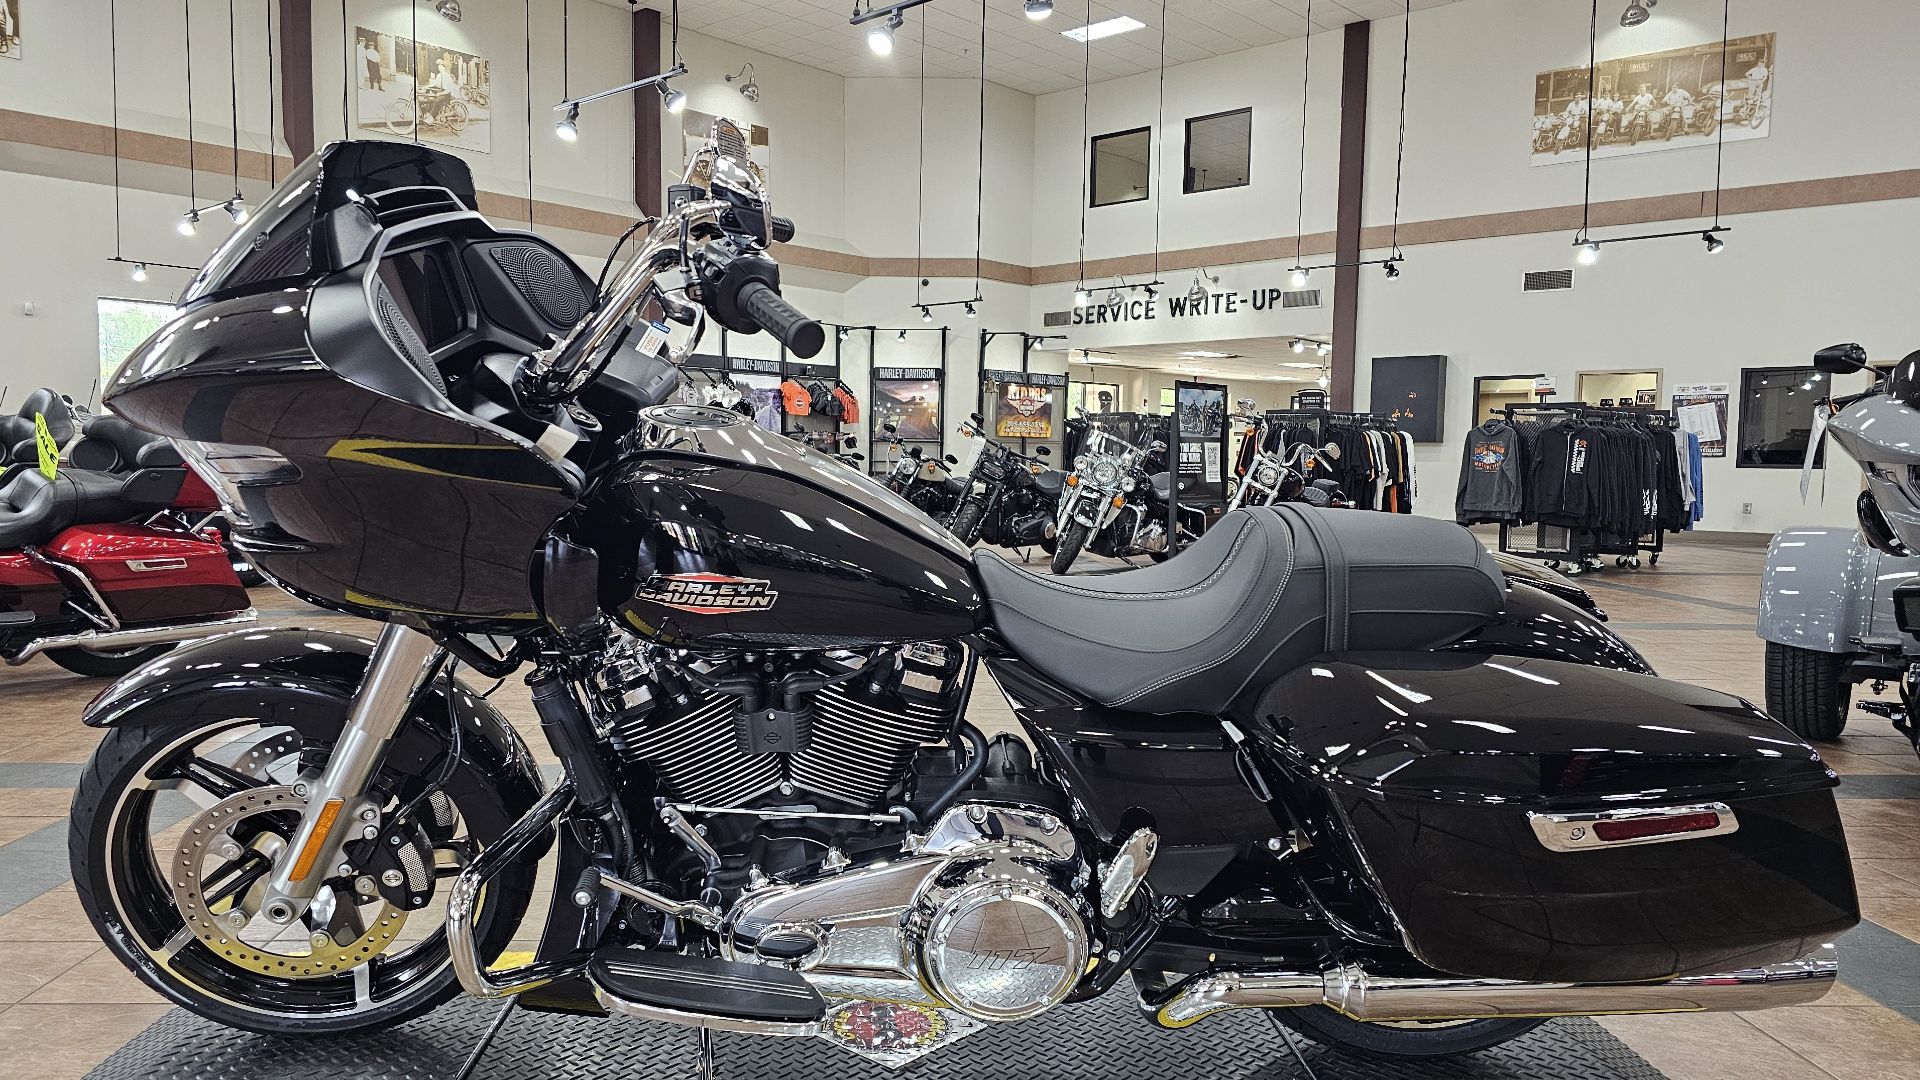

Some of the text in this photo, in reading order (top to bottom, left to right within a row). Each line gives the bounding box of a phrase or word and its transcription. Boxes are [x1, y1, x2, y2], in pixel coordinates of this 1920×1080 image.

[1072, 288, 1282, 325] SERVICE WRITE-UP
[732, 357, 780, 373] HARLEY-DAVIDSON
[879, 368, 936, 380] HARLEY-DAVIDSON
[639, 588, 770, 607] DAVIDSON
[966, 946, 1051, 970] 117
